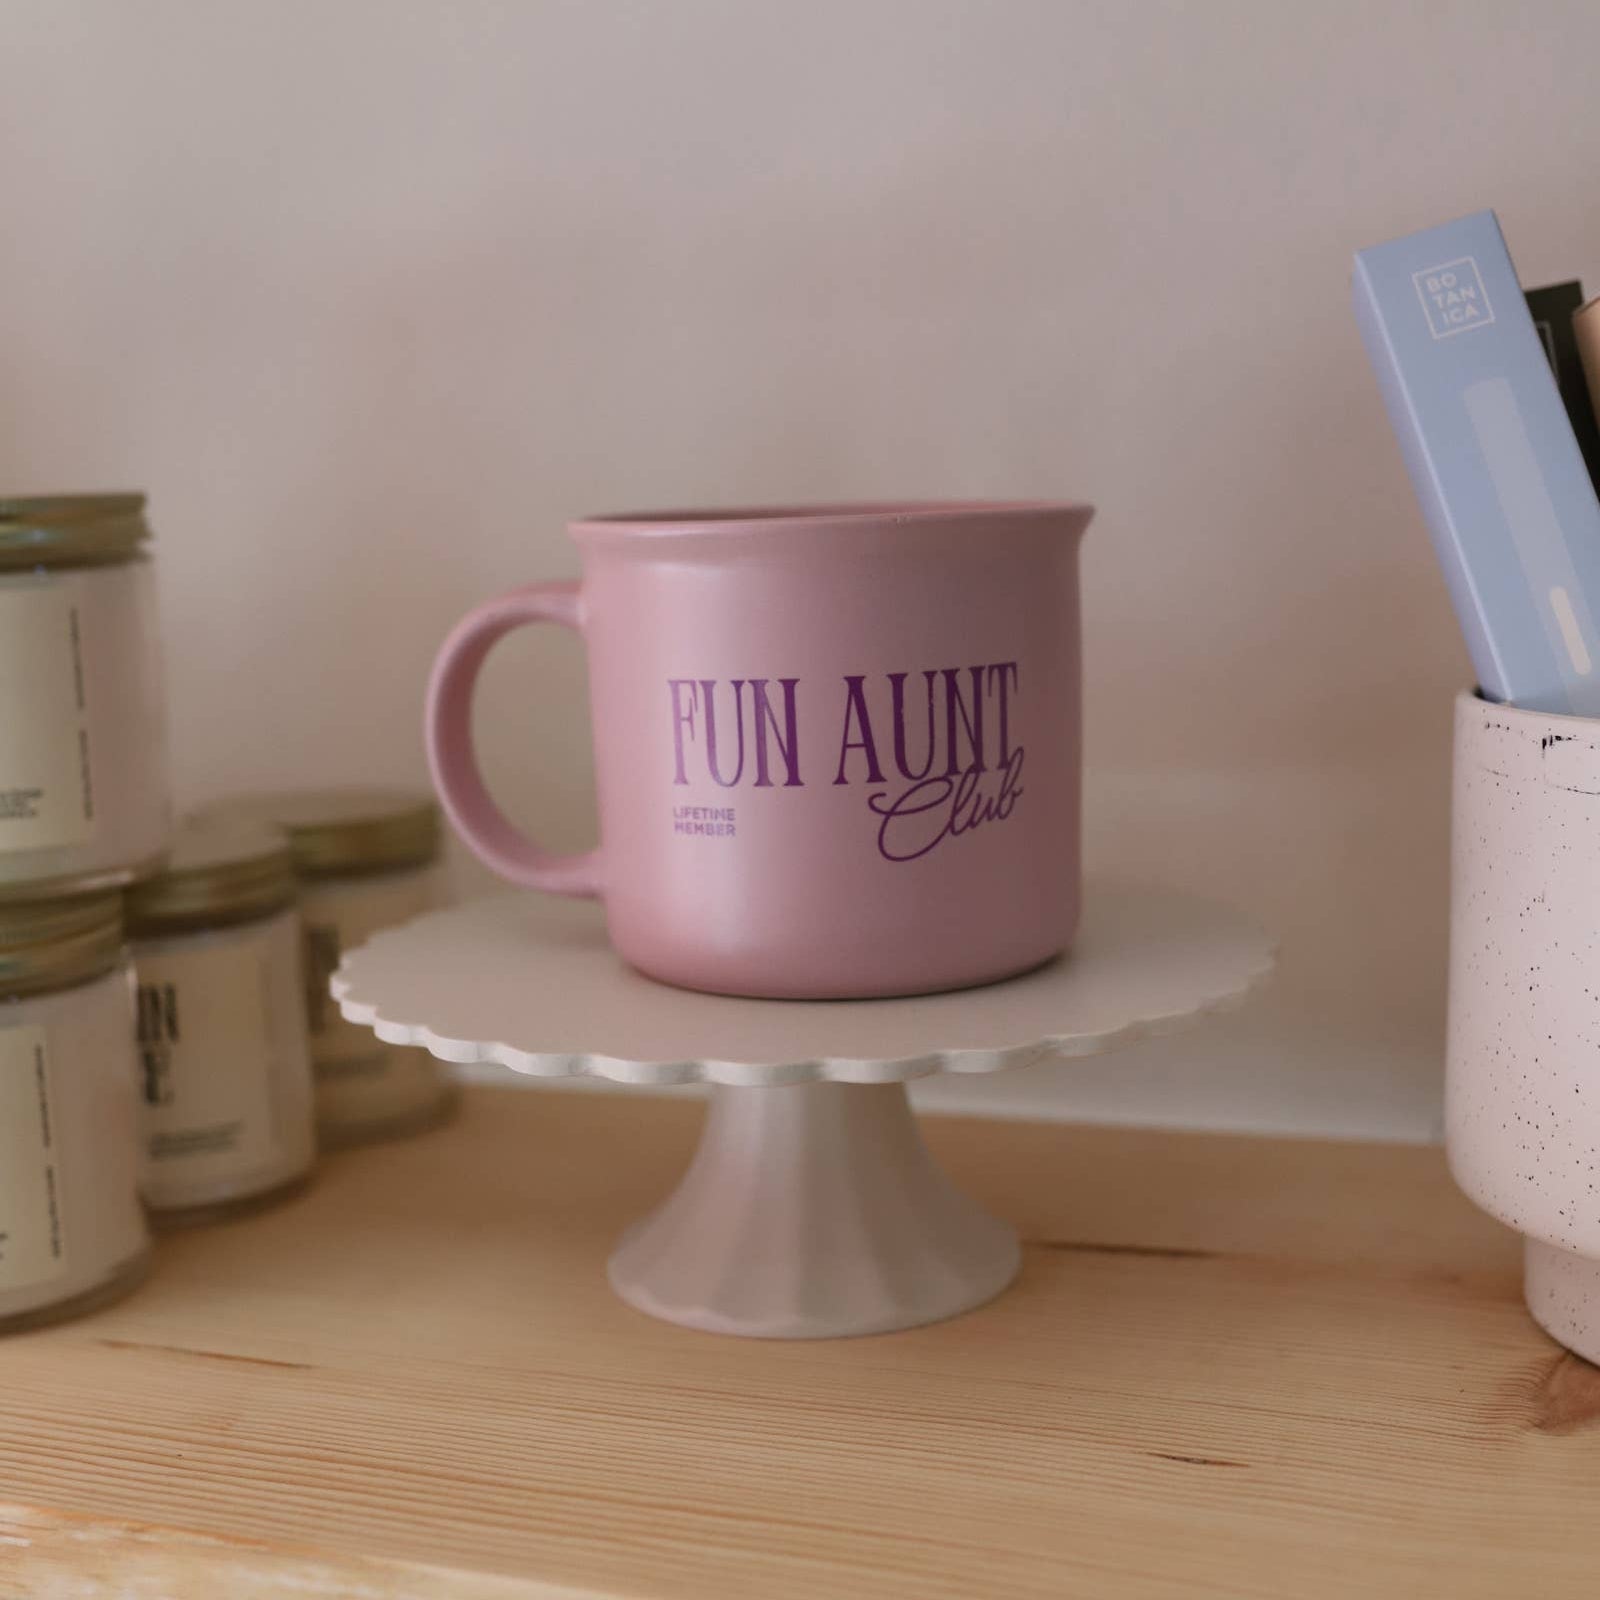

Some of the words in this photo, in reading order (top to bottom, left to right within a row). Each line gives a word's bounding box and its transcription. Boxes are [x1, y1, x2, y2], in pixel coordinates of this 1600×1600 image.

[1427, 272, 1457, 292] BO
[1433, 286, 1476, 309] TAN
[1442, 304, 1478, 324] ICA
[667, 678, 804, 787] FUN
[832, 662, 1018, 785] AUNT
[673, 806, 736, 821] LIFETIME
[868, 746, 1024, 862] Club
[674, 822, 736, 837] MEMBER
